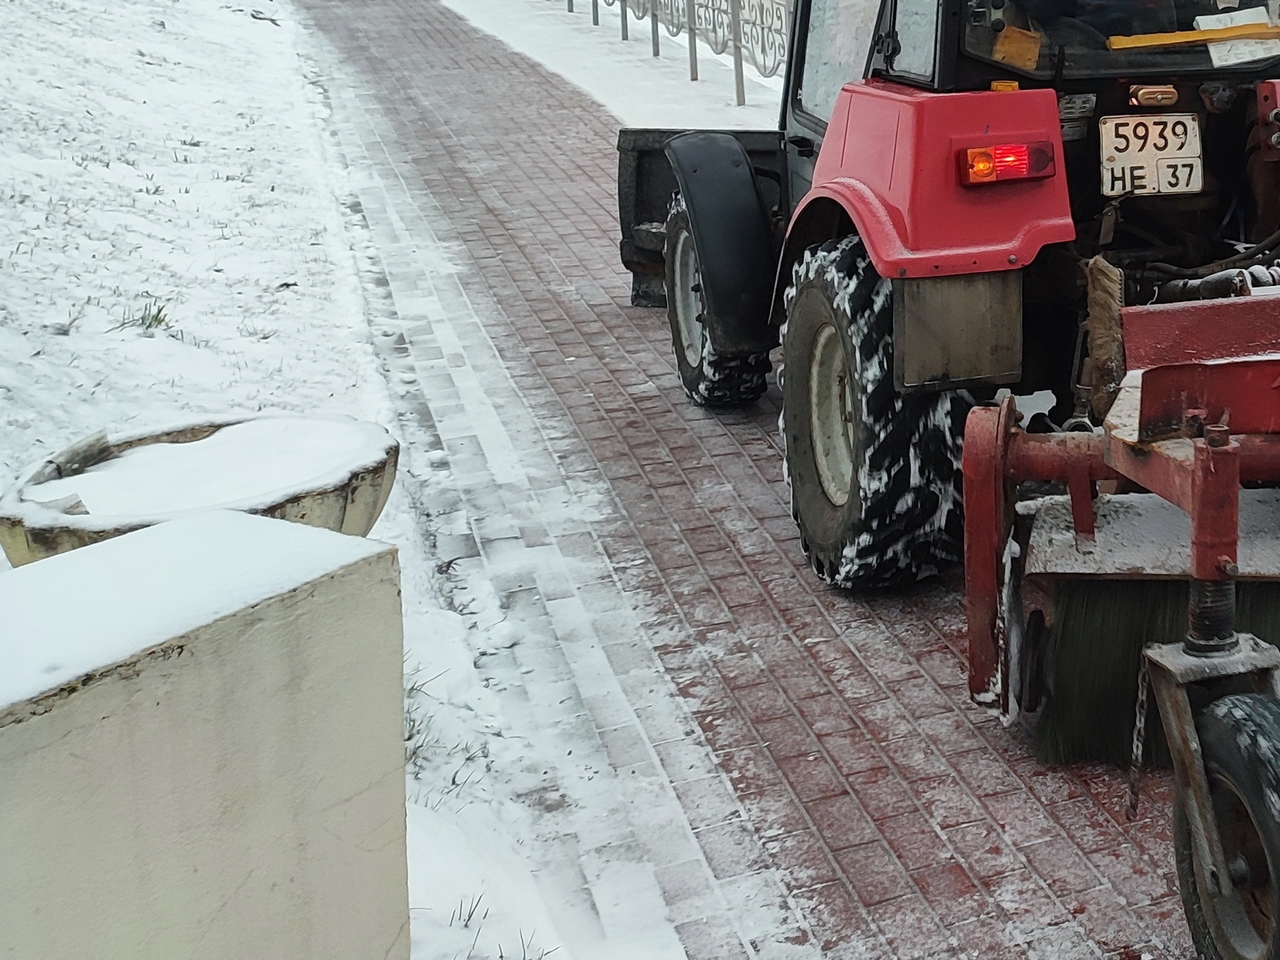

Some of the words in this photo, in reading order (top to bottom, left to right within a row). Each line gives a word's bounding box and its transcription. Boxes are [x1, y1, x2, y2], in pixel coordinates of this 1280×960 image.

[1113, 120, 1188, 154] 5939
[1110, 165, 1147, 192] НЕ
[1165, 163, 1194, 189] 37
